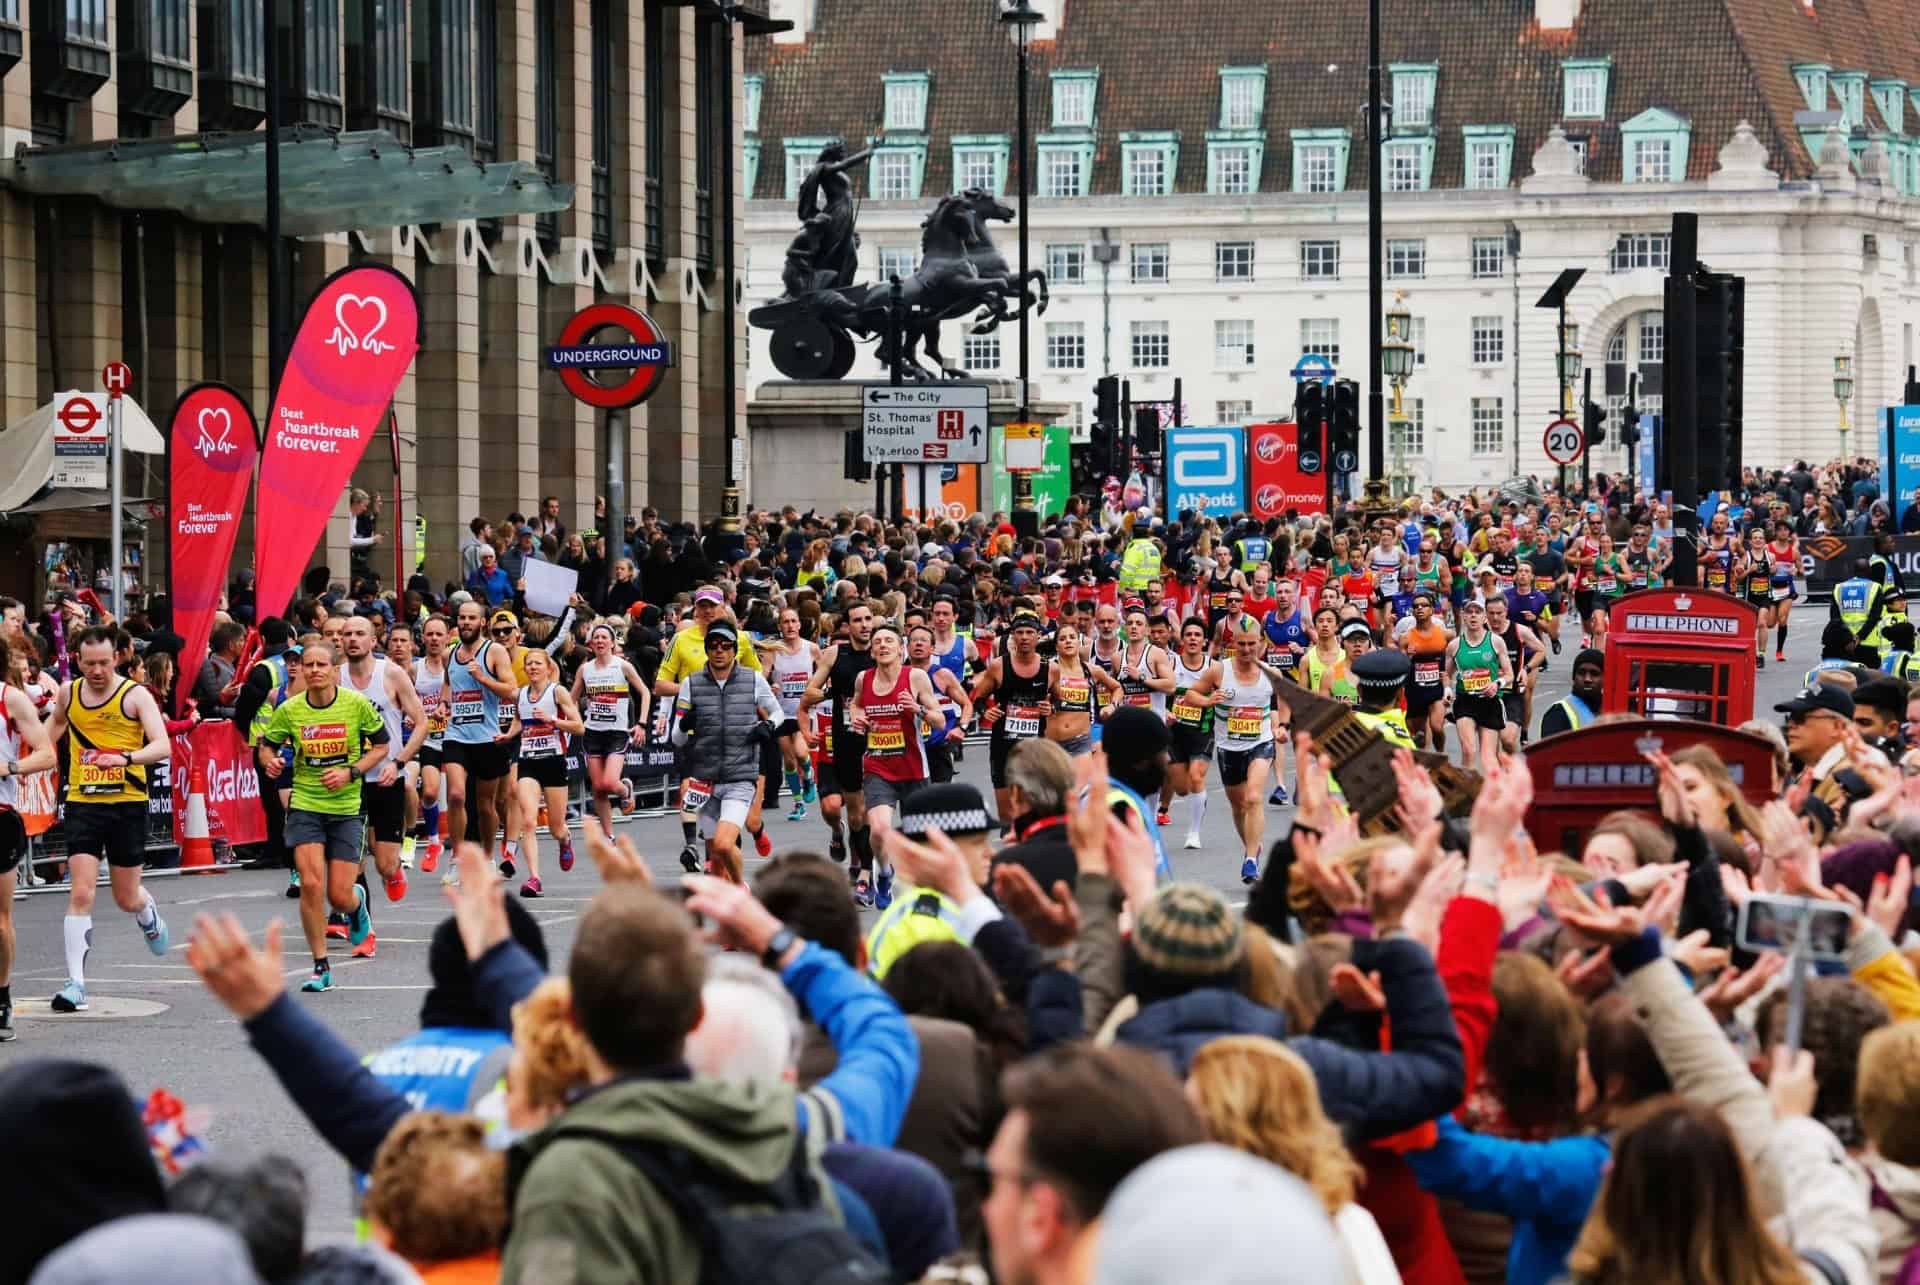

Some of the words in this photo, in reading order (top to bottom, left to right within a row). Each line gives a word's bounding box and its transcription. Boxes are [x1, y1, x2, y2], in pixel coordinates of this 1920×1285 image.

[553, 348, 661, 363] UNDERGROUND
[107, 367, 125, 388] H
[893, 391, 914, 402] The
[917, 391, 942, 403] City
[280, 407, 304, 420] Beat
[867, 412, 885, 423] St.
[942, 410, 959, 431] H
[285, 419, 360, 439] heartbreak
[867, 425, 915, 437] Hospital
[276, 431, 341, 453] forever.
[1549, 432, 1579, 451] 20
[1286, 494, 1324, 505] money
[178, 520, 218, 534] Forever
[1631, 615, 1736, 634] TELEPHONE
[307, 741, 345, 754] 31697
